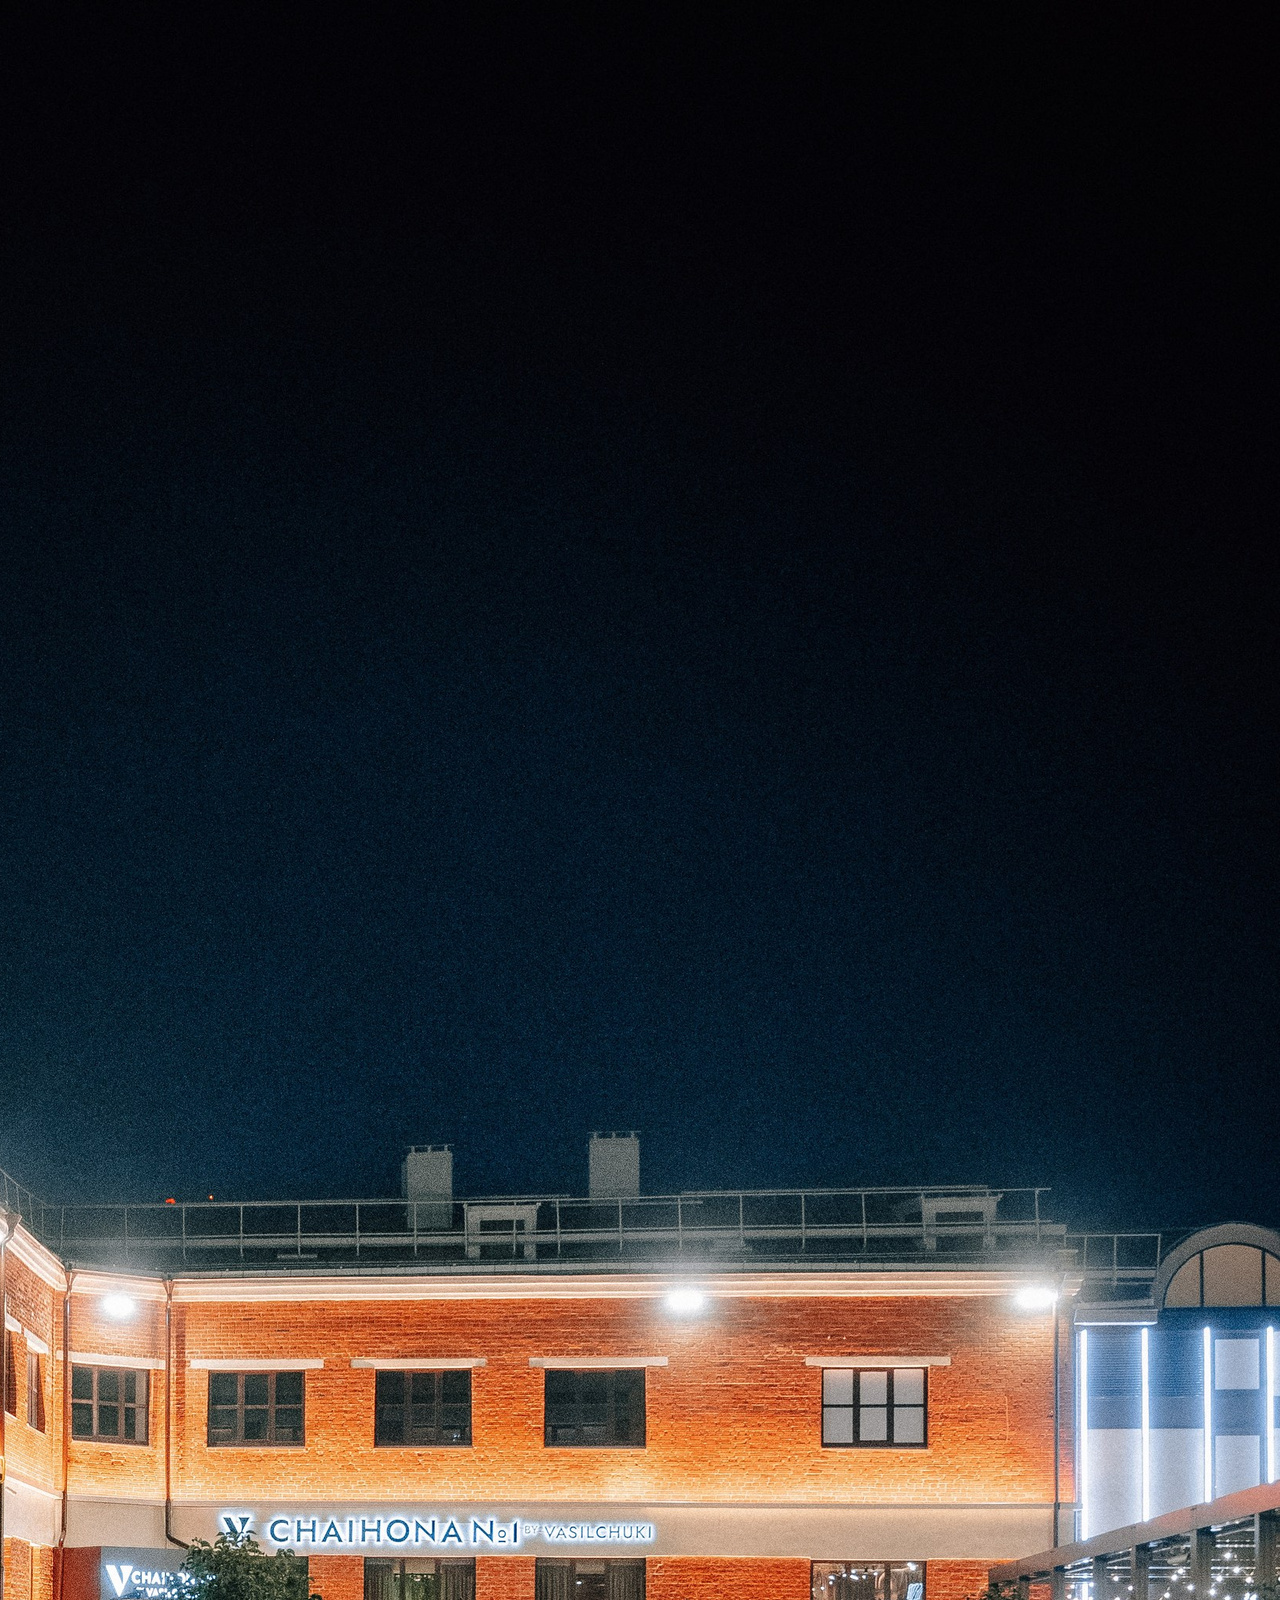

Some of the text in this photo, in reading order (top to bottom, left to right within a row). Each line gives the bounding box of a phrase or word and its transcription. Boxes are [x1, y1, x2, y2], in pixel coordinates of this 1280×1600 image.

[269, 1519, 462, 1543] CHAIHONA
[524, 1525, 538, 1535] BY
[544, 1525, 653, 1540] VASILCHUKI
